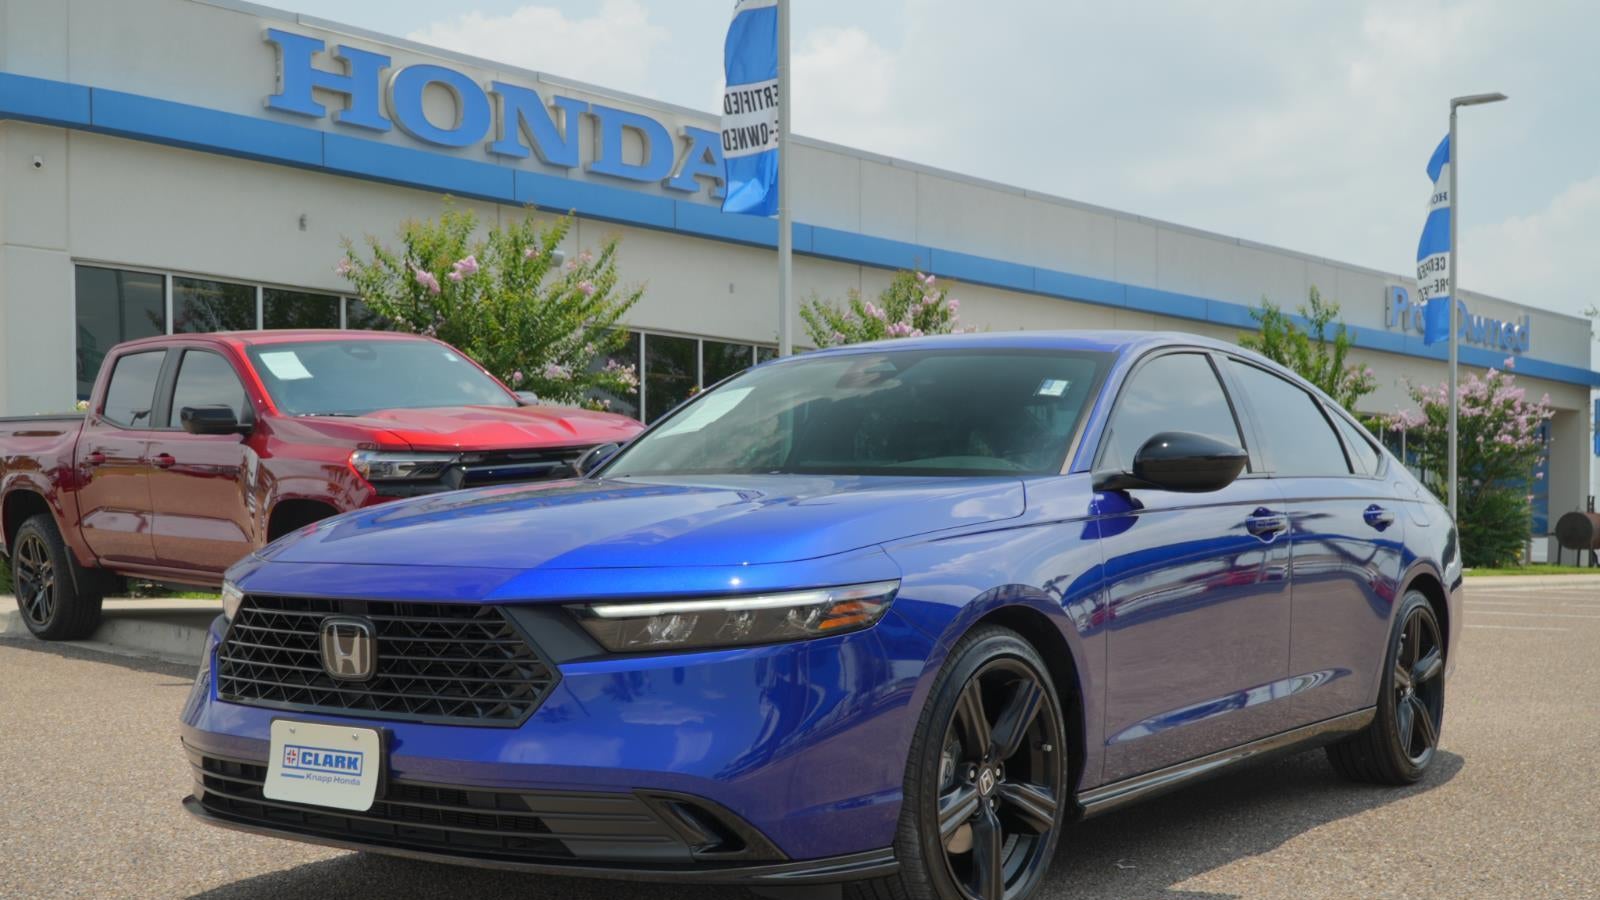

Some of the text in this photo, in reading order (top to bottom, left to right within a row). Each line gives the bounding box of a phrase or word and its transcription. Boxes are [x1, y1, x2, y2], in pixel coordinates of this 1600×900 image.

[264, 28, 725, 199] HONDA
[301, 751, 358, 770] CLARK
[305, 773, 360, 786] Knapp Honda
